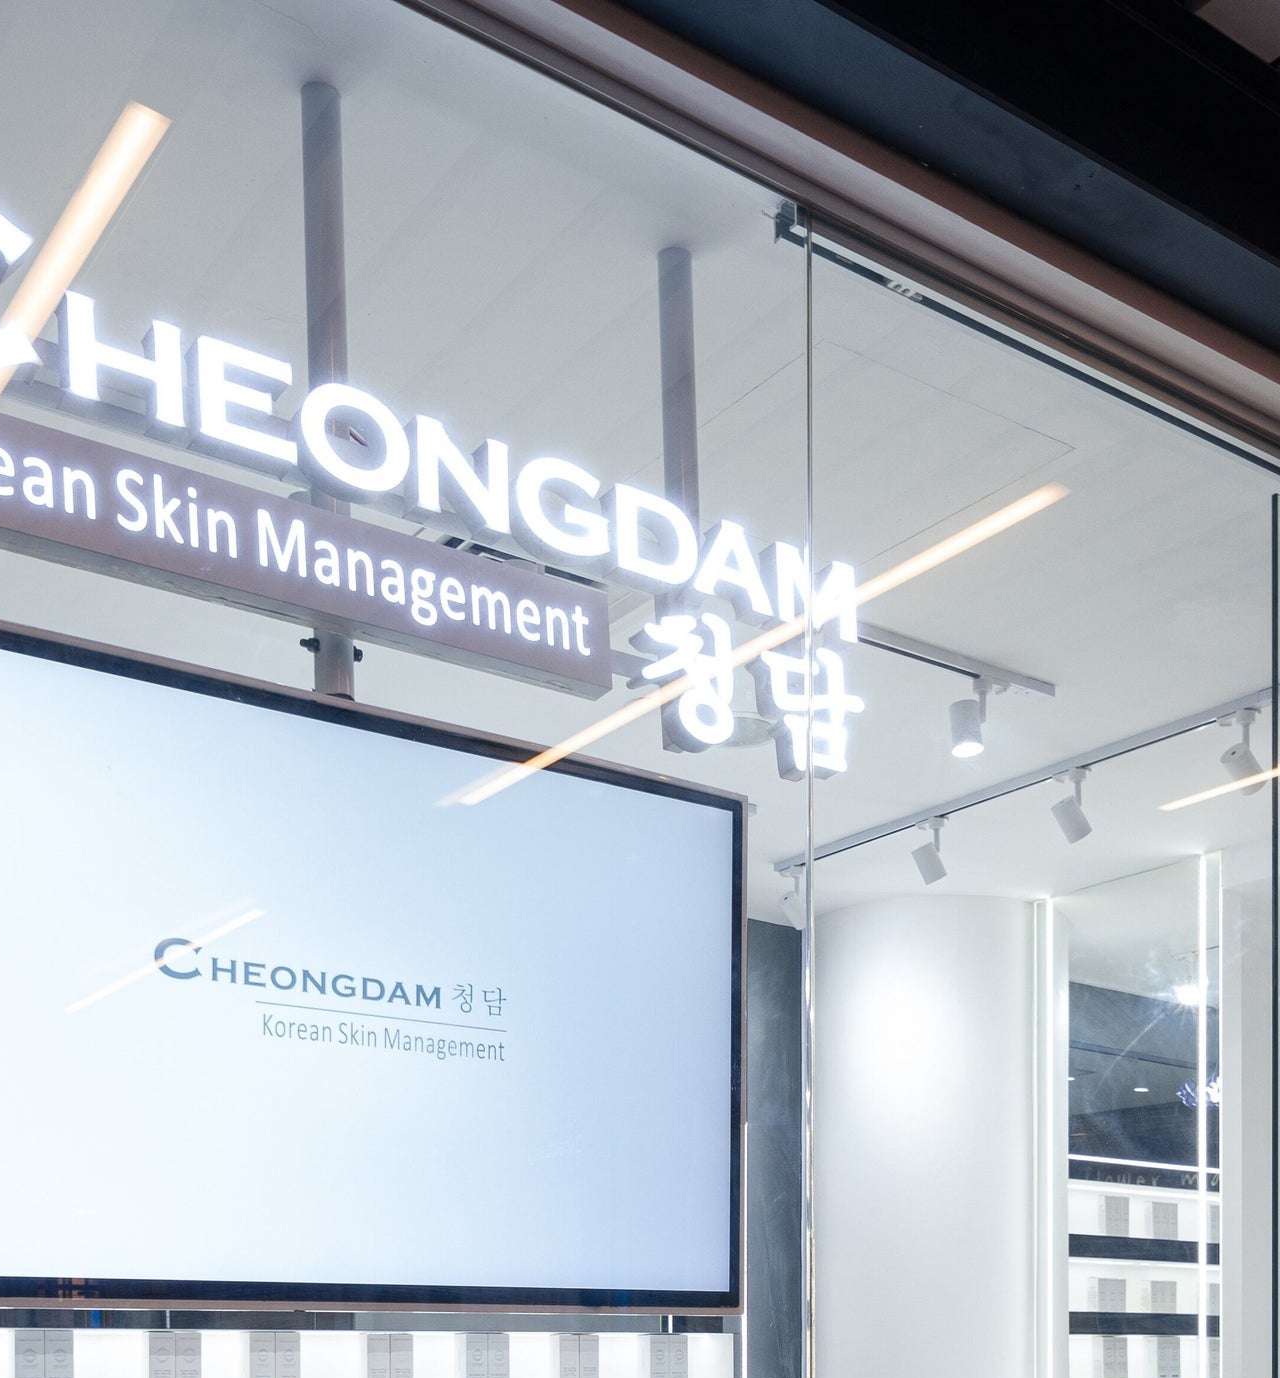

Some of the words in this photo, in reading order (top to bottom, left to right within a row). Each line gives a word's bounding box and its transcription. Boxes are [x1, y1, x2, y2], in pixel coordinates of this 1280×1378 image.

[115, 468, 239, 560] Skin
[258, 520, 592, 659] Management
[643, 607, 863, 780] 청담
[154, 937, 441, 1010] CHEONGDAM
[451, 982, 508, 1017] 청담
[262, 1013, 332, 1044] Korean
[338, 1022, 377, 1048] Skin
[384, 1027, 505, 1062] Management
